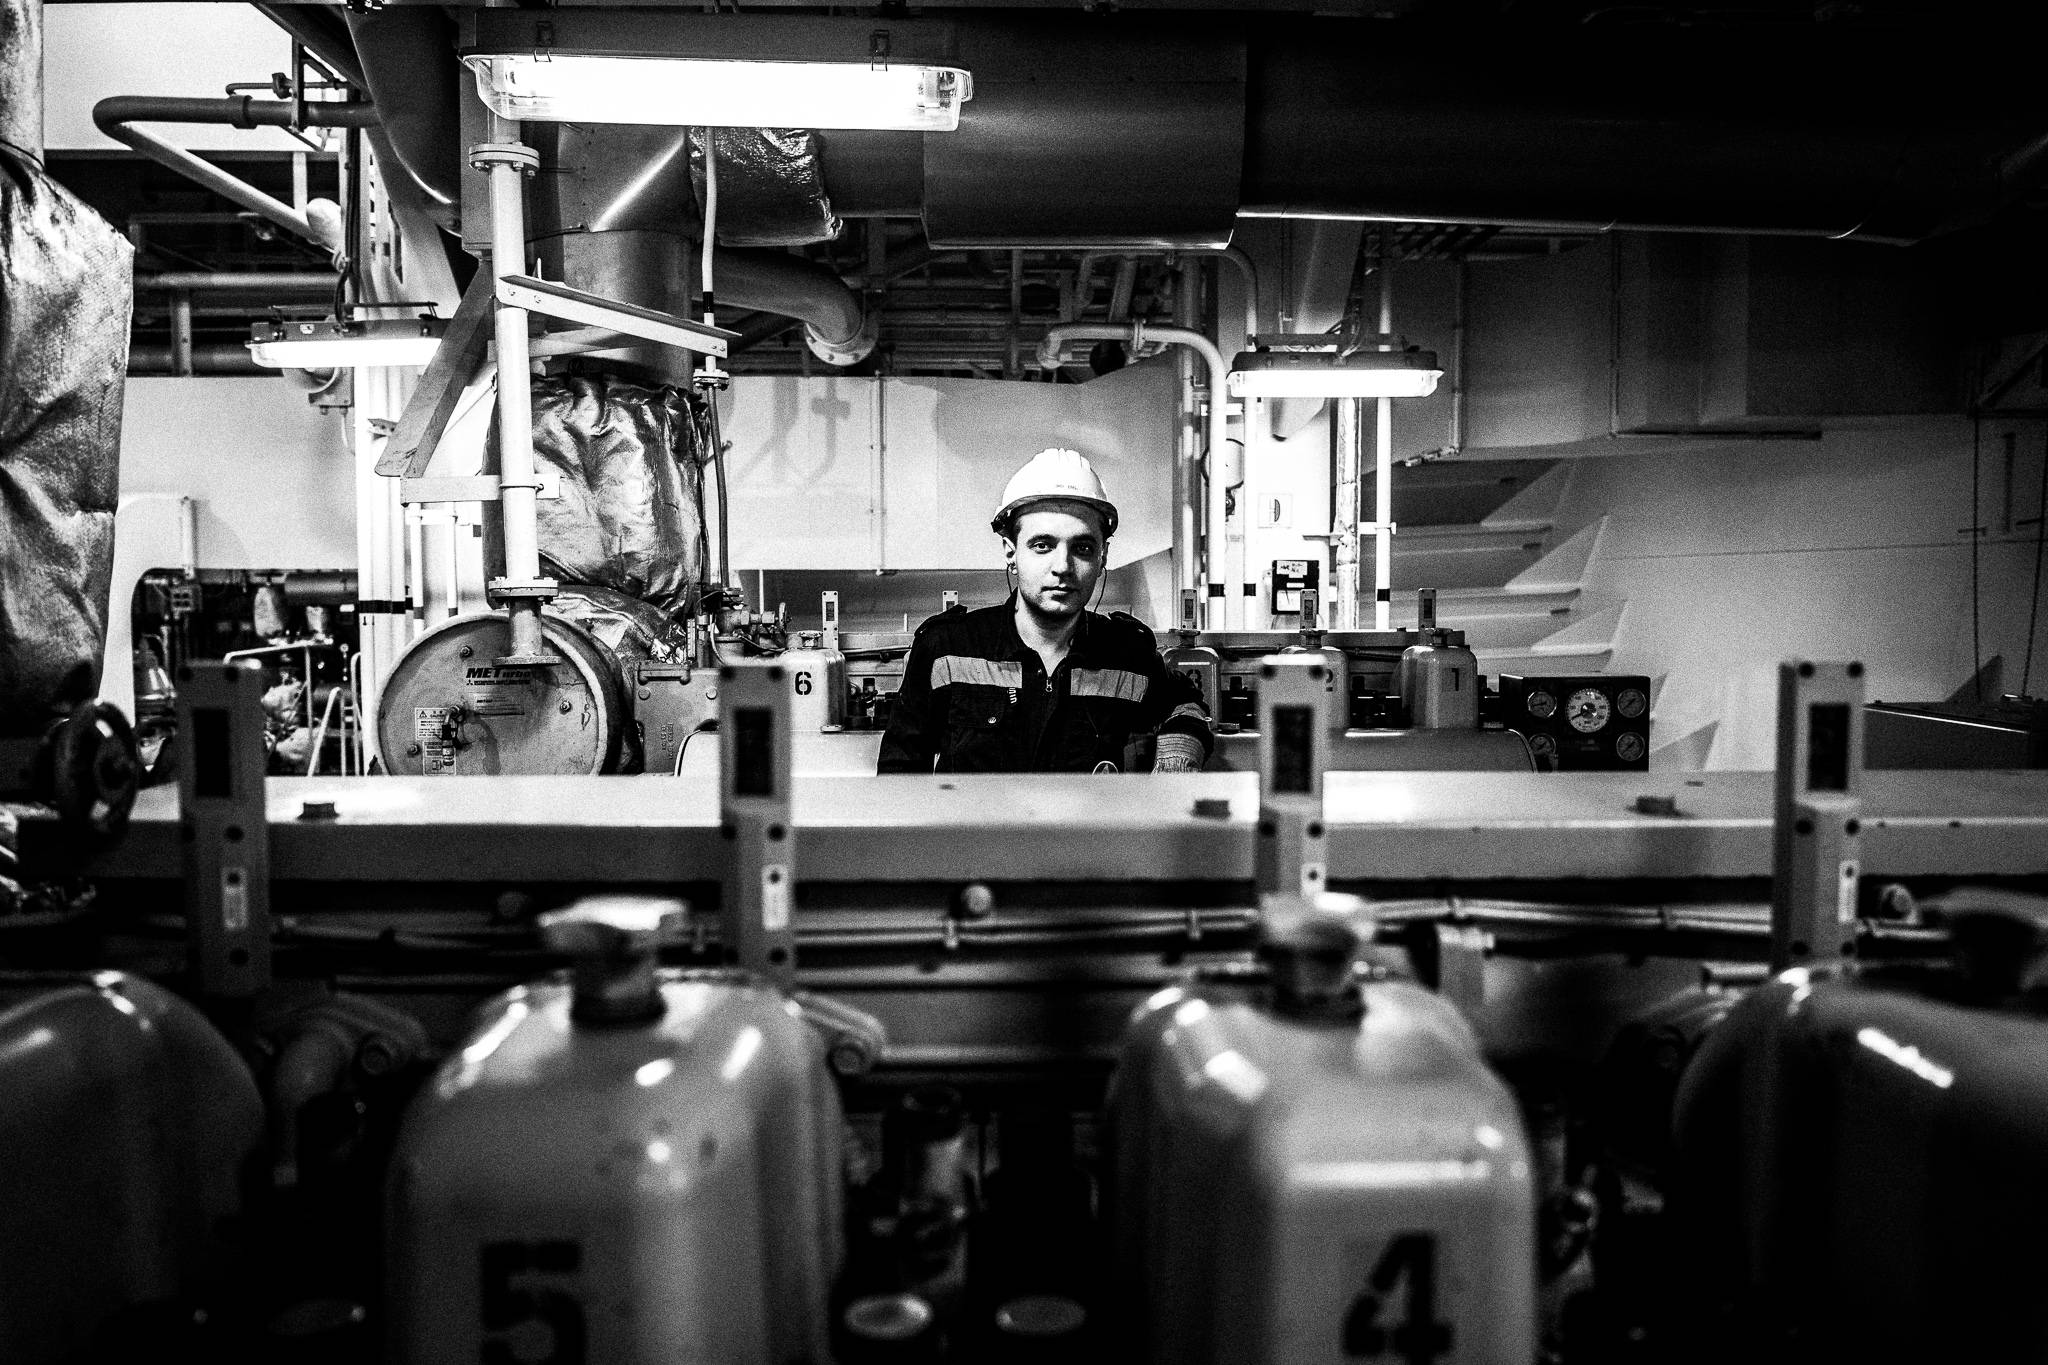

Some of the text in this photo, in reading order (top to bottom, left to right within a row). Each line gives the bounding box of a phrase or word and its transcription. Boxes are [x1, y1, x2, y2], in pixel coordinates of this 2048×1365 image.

[795, 671, 812, 696] 6
[1451, 667, 1460, 692] 1
[480, 1238, 585, 1365] 5
[1341, 1230, 1455, 1365] 4
